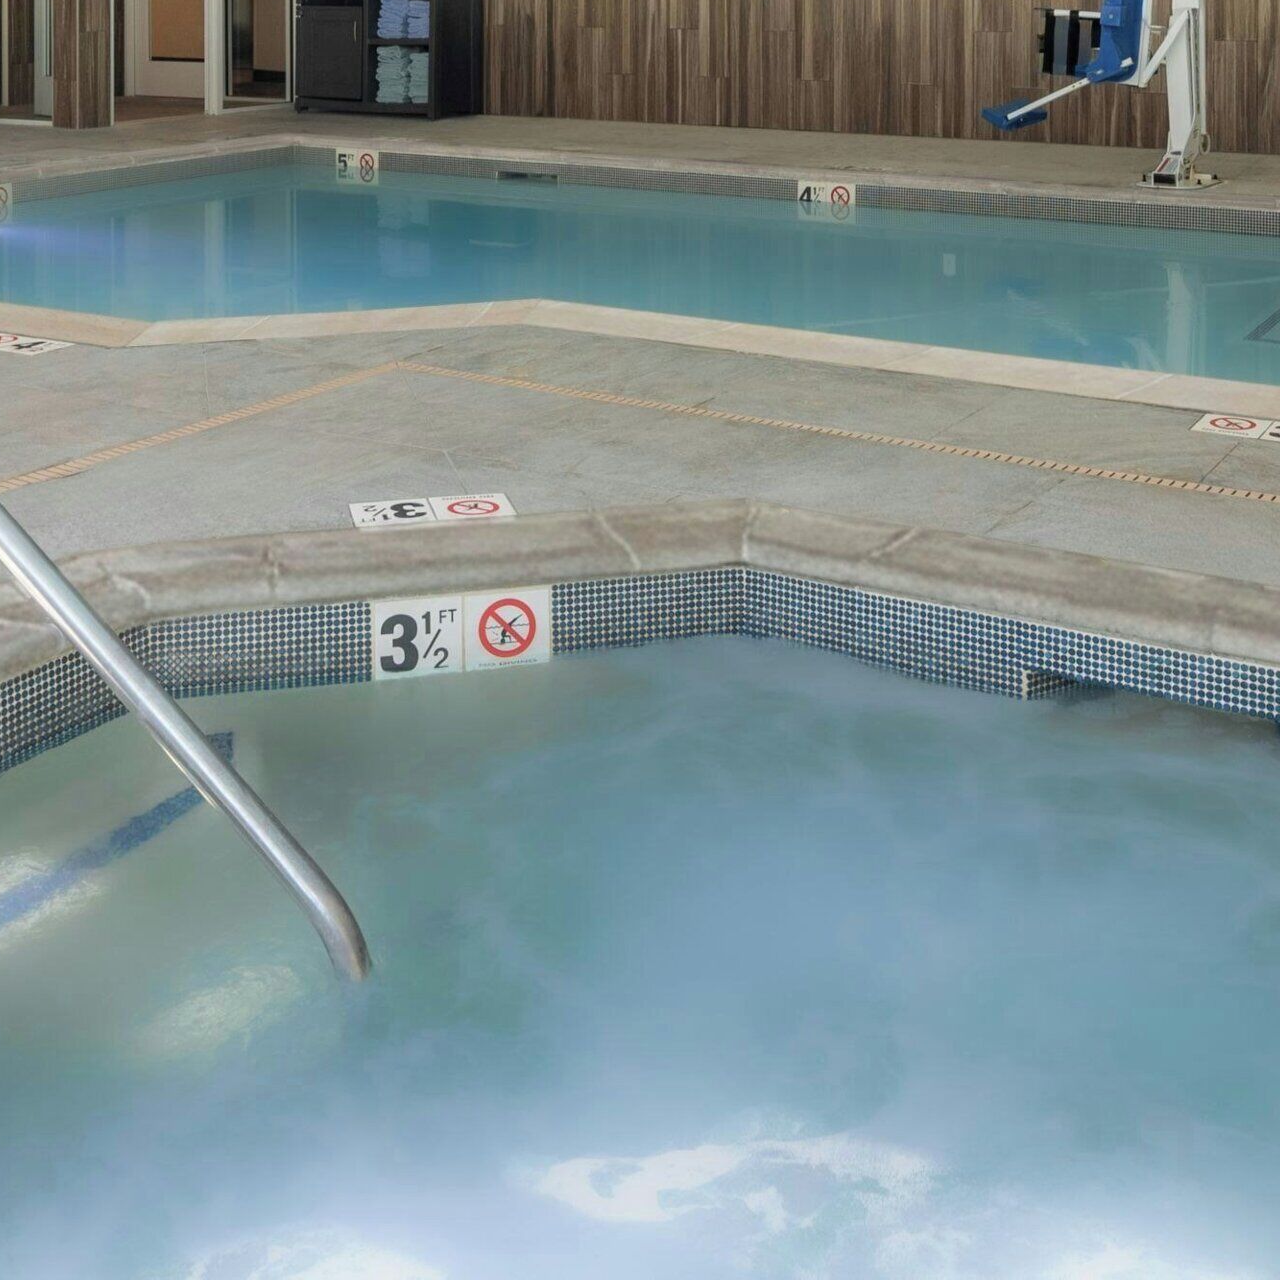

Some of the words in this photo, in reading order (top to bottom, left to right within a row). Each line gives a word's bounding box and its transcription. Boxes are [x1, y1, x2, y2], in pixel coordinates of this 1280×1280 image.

[338, 153, 347, 168] 5
[799, 186, 812, 203] 4
[390, 502, 428, 519] 3
[380, 614, 419, 673] 3
[438, 608, 458, 624] FT
